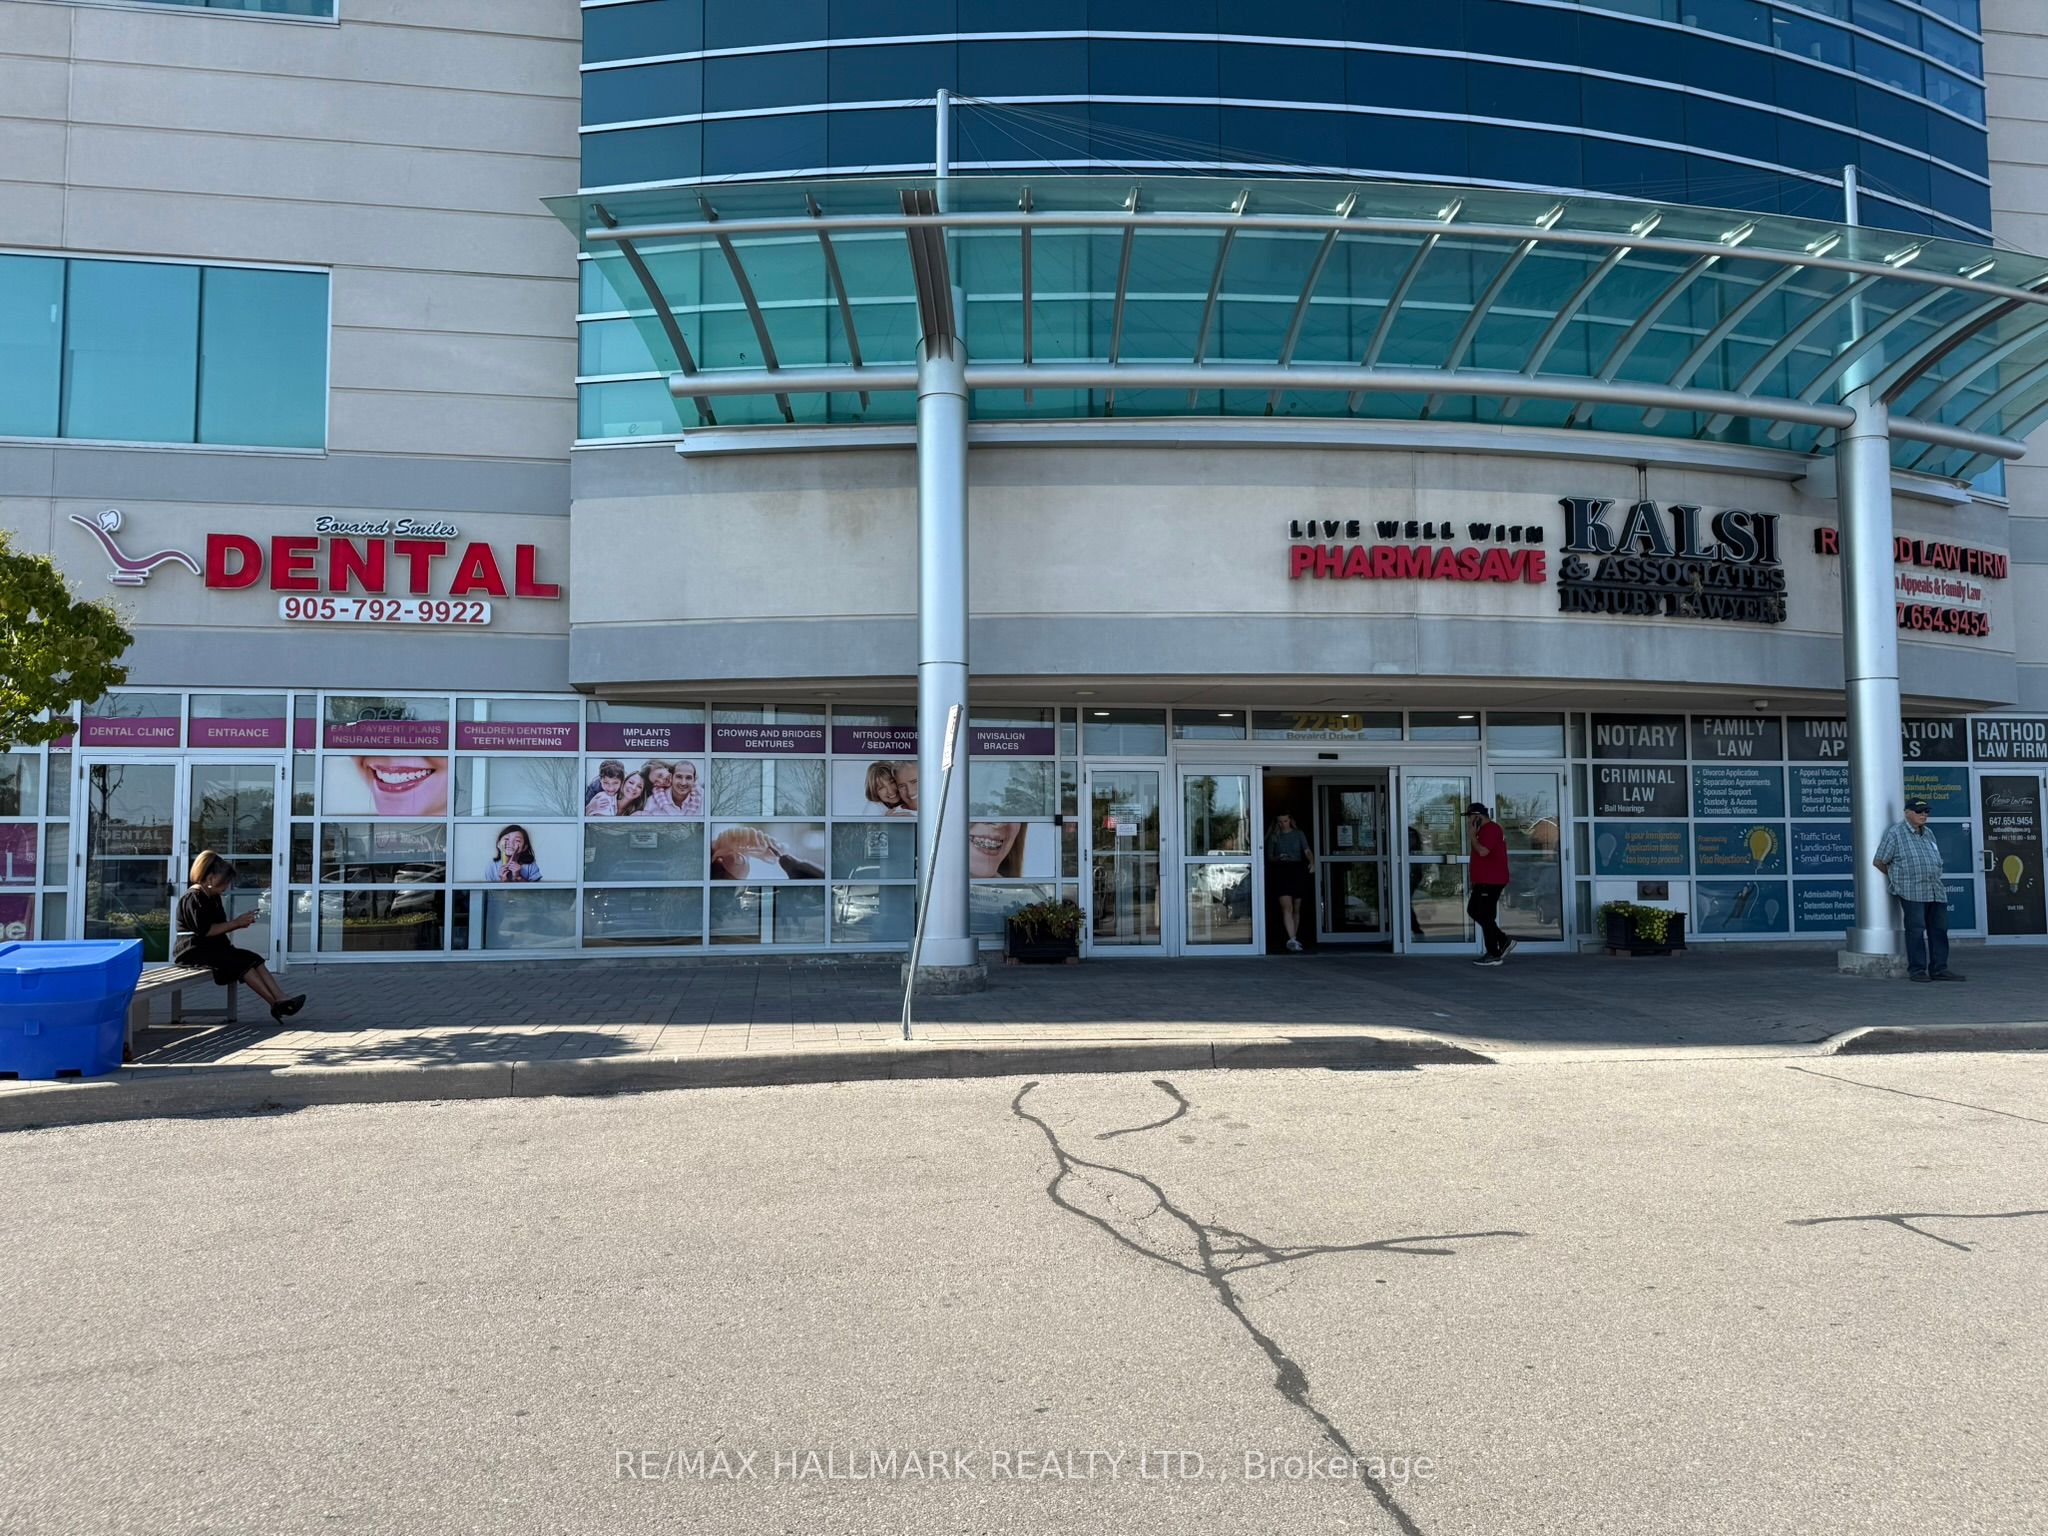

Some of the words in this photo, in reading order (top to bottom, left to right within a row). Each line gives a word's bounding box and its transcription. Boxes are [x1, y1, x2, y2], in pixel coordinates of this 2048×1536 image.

[315, 515, 389, 535] Bovaird
[393, 518, 459, 537] Smiles
[1558, 496, 1782, 566] KALSI
[1288, 520, 1360, 541] LIVE
[1374, 521, 1455, 542] WELL
[1466, 522, 1544, 546] WITH
[1289, 544, 1547, 583] PHARMASAVE
[1914, 540, 1961, 571] LAW
[1961, 548, 2008, 579] FIRM
[204, 532, 561, 598] DENTAL
[1559, 554, 1590, 580] &
[1594, 556, 1786, 592] ASSOCIATES
[1901, 573, 1933, 596] Appeals
[1934, 578, 1941, 595] &
[1941, 579, 1966, 602] Family
[1967, 584, 1981, 601] Law
[285, 597, 485, 623] 905-792-9922
[1558, 587, 1664, 615] INJURY
[1664, 592, 1787, 624] LAWYERS
[1896, 602, 1989, 637] 7.654.9454
[1292, 711, 1364, 732] 2250
[89, 727, 134, 736] DENTAL
[137, 727, 175, 737] CLINIC
[331, 725, 356, 733] EASY
[360, 725, 406, 734] PAYMENT
[408, 725, 442, 734] PLANS
[464, 726, 514, 735] CHILDREN
[516, 726, 571, 735] DENTISTRY
[1703, 718, 1765, 736] FAMILY
[1977, 721, 2046, 741] RATHOD
[208, 728, 269, 738] ENTRANCE
[623, 728, 671, 737] IMPLANTS
[717, 729, 759, 737] CROWNS
[760, 729, 779, 738] AND
[781, 730, 822, 738] BRIDGES
[852, 731, 892, 739] NITROUS
[894, 731, 919, 740] OXIDE
[977, 732, 1025, 740] INVISALIGN
[1597, 724, 1678, 747] NOTARY
[332, 735, 391, 744] INSURANCE
[393, 736, 439, 745] BILLINGS
[472, 736, 505, 745] TEETH
[507, 737, 562, 746] WHITENING
[624, 739, 669, 747] VENEERS
[745, 739, 795, 748] DENTURES
[867, 741, 911, 750] SEDATION
[983, 742, 1019, 750] BRACES
[1717, 739, 1753, 757] LAW
[1978, 742, 2008, 758] LAW
[2013, 742, 2048, 758] FIRM
[1601, 768, 1675, 784] CRIMINAL
[1702, 769, 1725, 777] Divorce
[1725, 769, 1759, 778] Application
[1800, 769, 1820, 777] Appeal
[1703, 778, 1734, 788] Separation
[1735, 778, 1771, 788] Agreements
[1623, 787, 1655, 802] LAW
[1703, 788, 1727, 797] Spousal
[1728, 788, 1752, 797] Support
[1831, 787, 1844, 795] type
[1703, 797, 1728, 807] Custody
[1736, 798, 1757, 806] Access
[1617, 805, 1645, 814] Hearings
[1704, 807, 1732, 815] Domestic
[1732, 807, 1757, 815] Violence
[1989, 816, 2033, 825] 647.654.9454
[102, 829, 163, 840] DENTAL
[1800, 855, 1819, 863] Small
[1820, 855, 1843, 863] Claims
[1803, 891, 1843, 899] Admissibility
